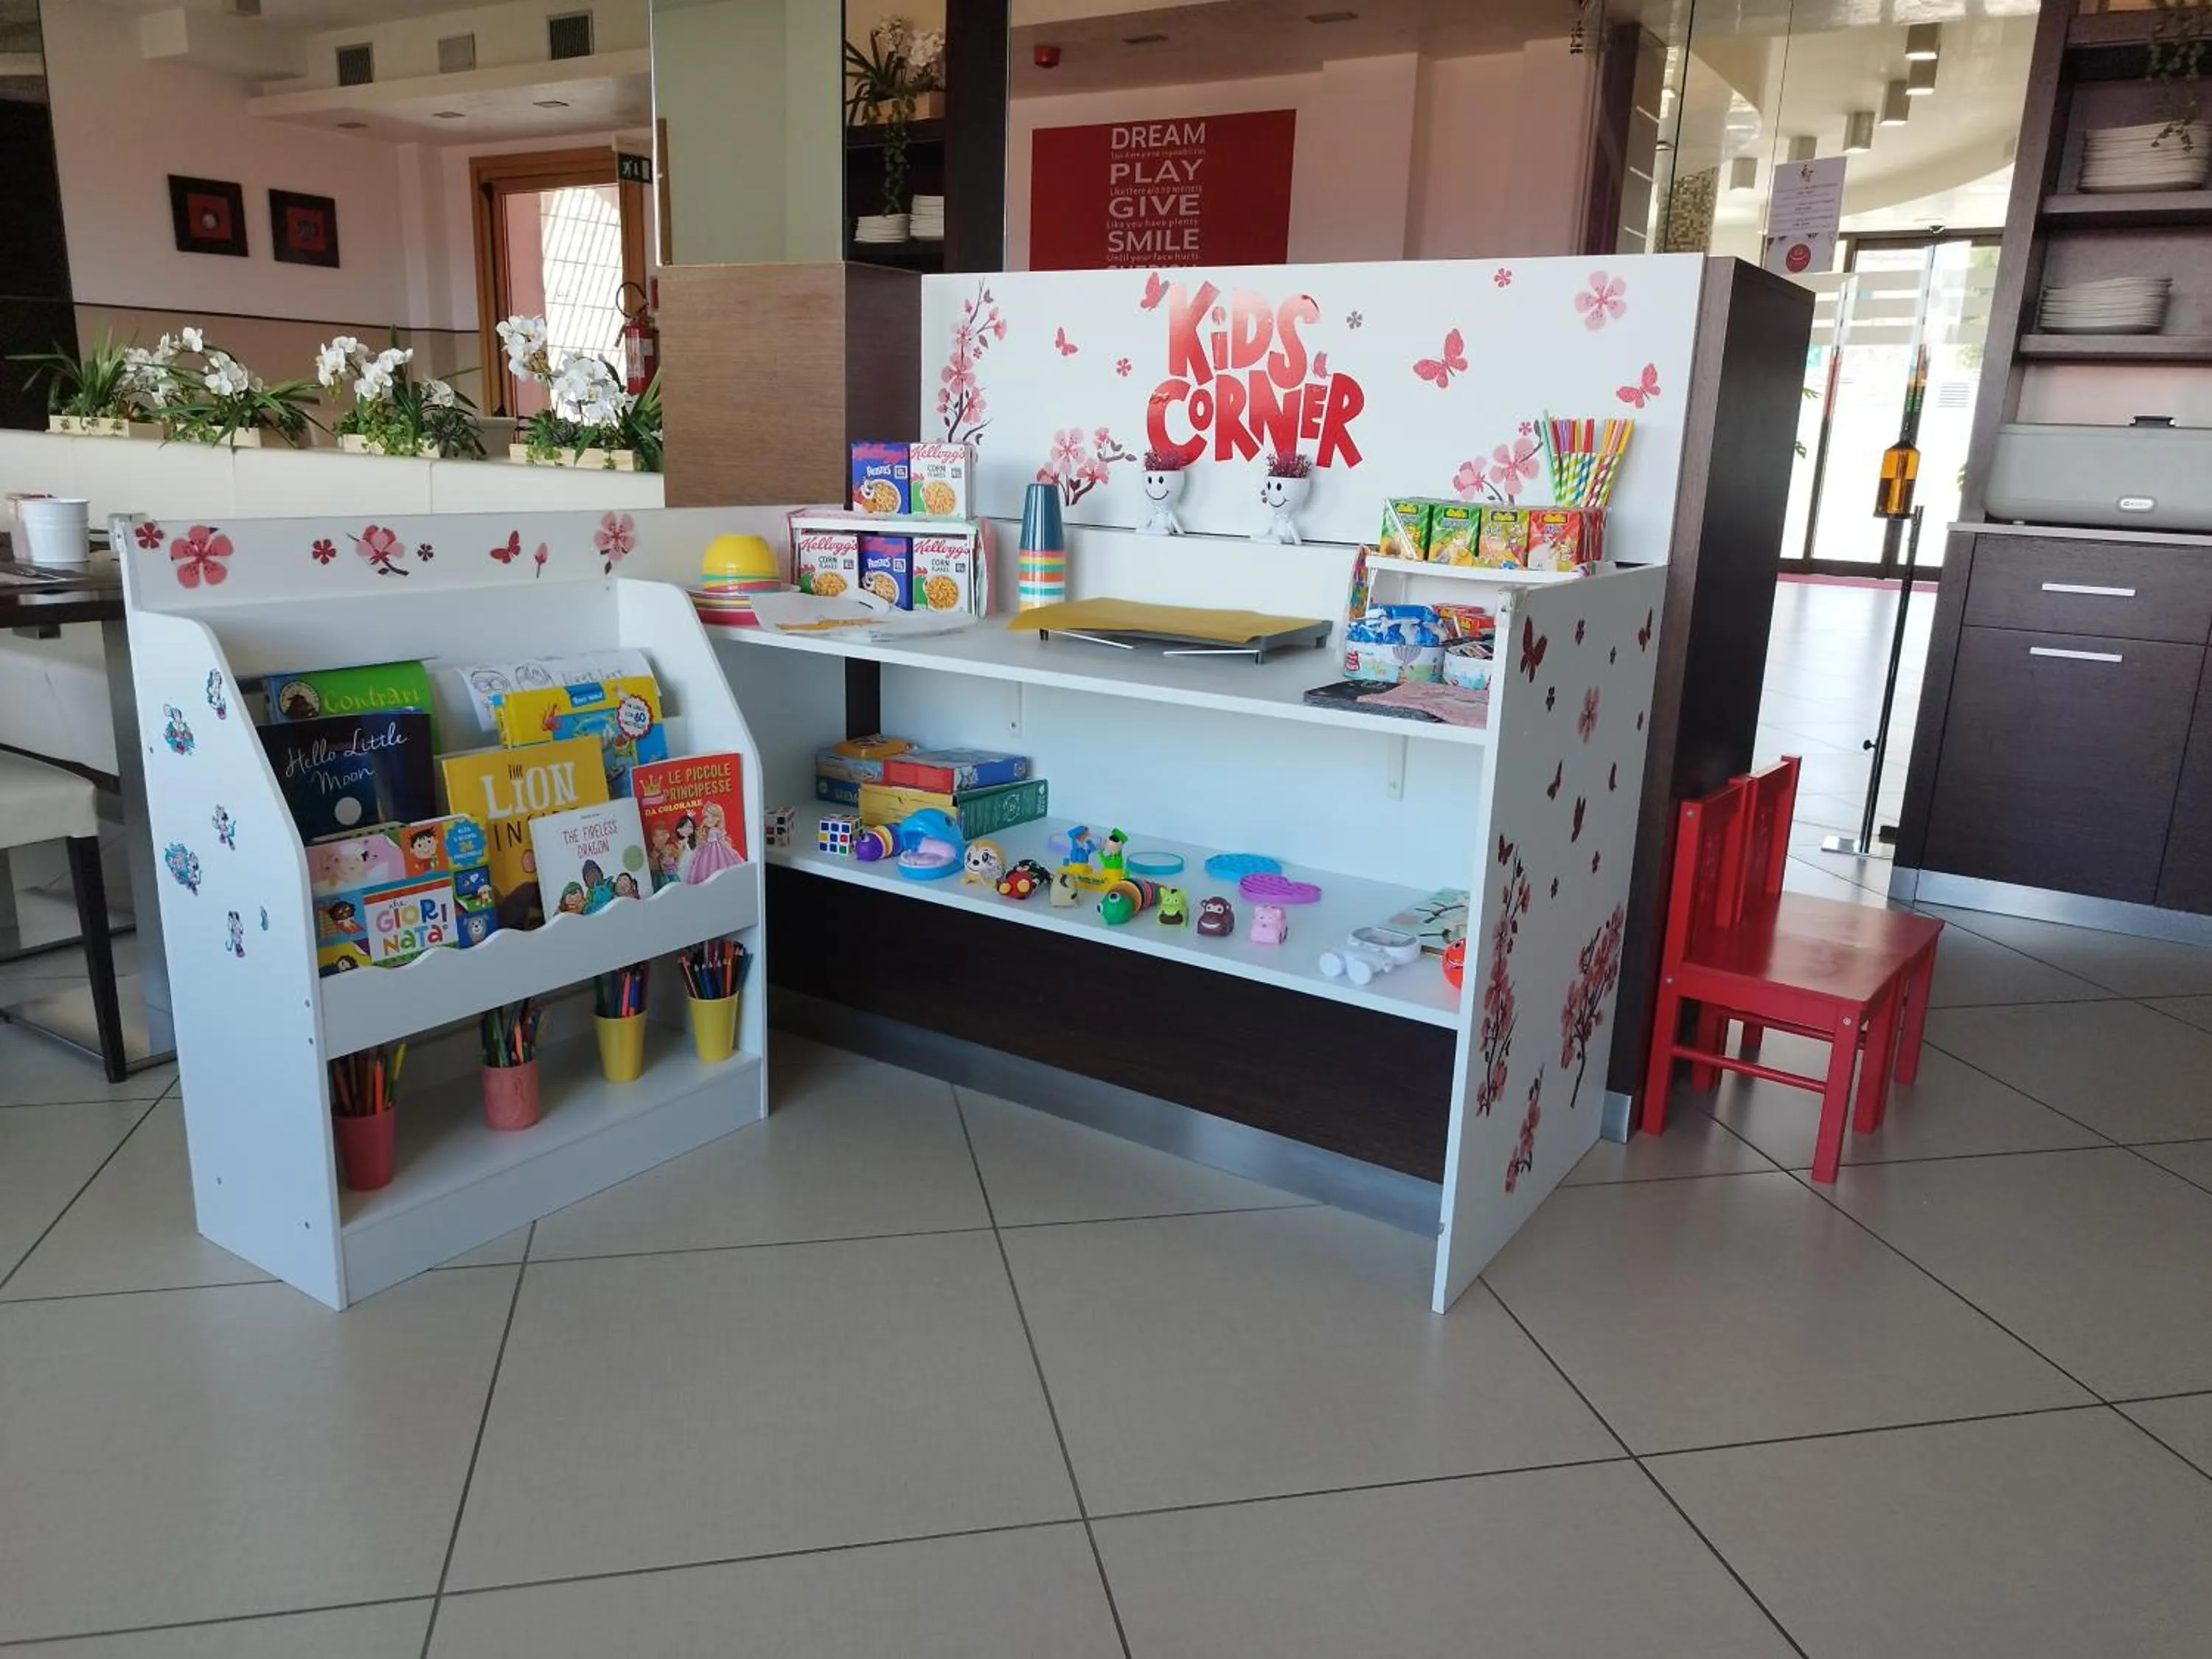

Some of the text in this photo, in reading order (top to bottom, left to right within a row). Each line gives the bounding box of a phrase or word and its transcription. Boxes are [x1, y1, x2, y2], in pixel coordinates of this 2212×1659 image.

[1111, 122, 1206, 150] DREAM
[1110, 159, 1203, 184] PLAY
[1108, 194, 1200, 218] GIVE
[1108, 229, 1199, 252] SMILE
[1147, 369, 1364, 468] CORNER
[910, 444, 966, 463] Kellogg's
[928, 465, 946, 473] CORN
[801, 536, 858, 556] Kellogg's
[818, 555, 838, 564] CORN
[324, 685, 420, 714] Contrari
[285, 722, 407, 778] Hello Little
[312, 765, 375, 795] Moon
[669, 762, 731, 784] LE PICCOLE
[481, 761, 578, 819] LION
[663, 779, 731, 801] PRINCIPESSE
[646, 799, 703, 817] DA COLORARE
[561, 828, 579, 845] THE
